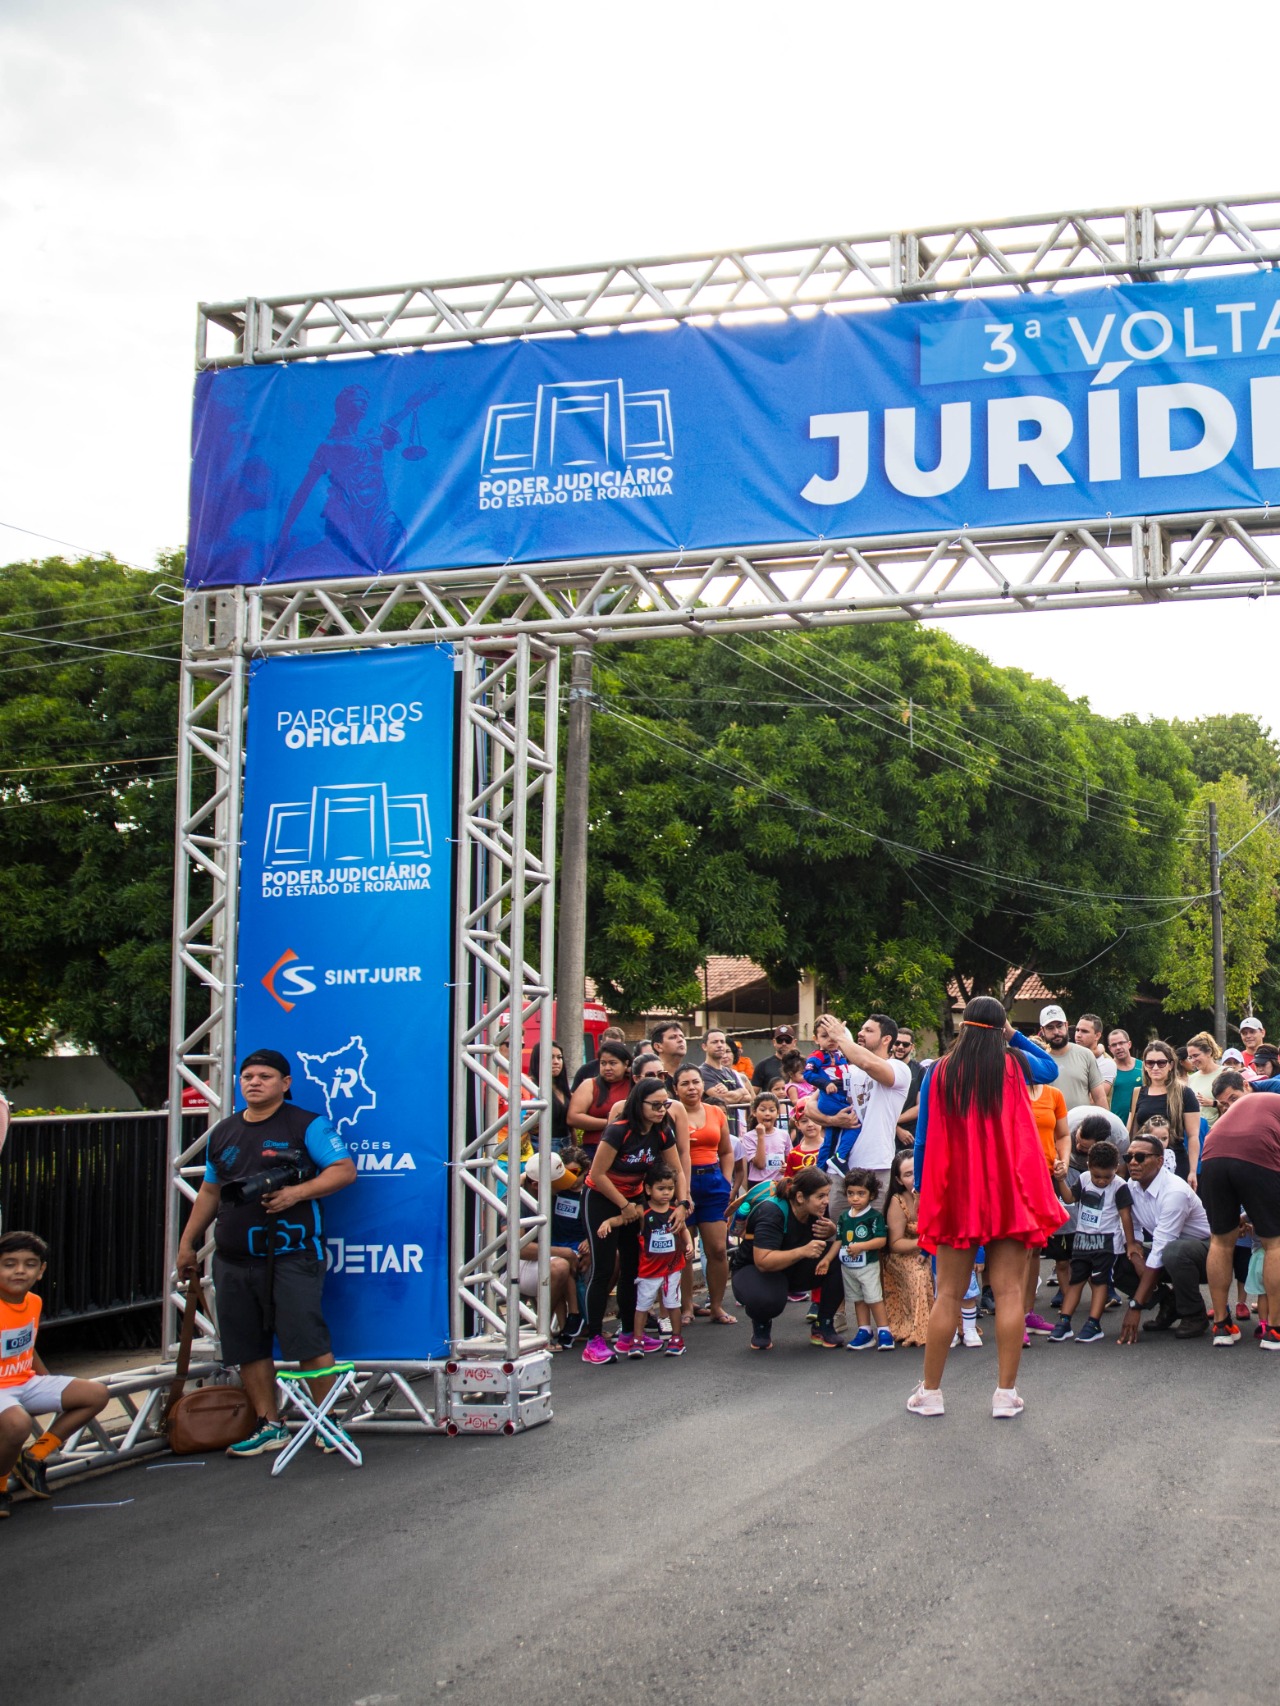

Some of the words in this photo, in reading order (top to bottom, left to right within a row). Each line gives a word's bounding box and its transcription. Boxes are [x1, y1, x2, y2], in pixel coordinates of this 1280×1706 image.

[479, 476, 549, 497] PODER
[553, 465, 673, 491] JUDICIÁRIO
[479, 497, 503, 510] DO
[507, 492, 567, 507] ESTADO
[572, 489, 593, 502] DE
[597, 483, 673, 500] RORAIMA
[277, 701, 423, 731] PARCEIROS
[285, 721, 406, 749] OFICIAIS
[262, 868, 322, 886] PODER
[326, 861, 431, 883] JUDICIÁRIO
[262, 886, 283, 898] DO
[286, 883, 339, 896] ESTADO
[343, 882, 361, 893] DE
[364, 878, 431, 892] RORAIMA
[324, 966, 422, 985] SINTJURR
[357, 1152, 416, 1170] IMA
[326, 1237, 424, 1273] JETAR
[653, 1240, 672, 1248] 0904
